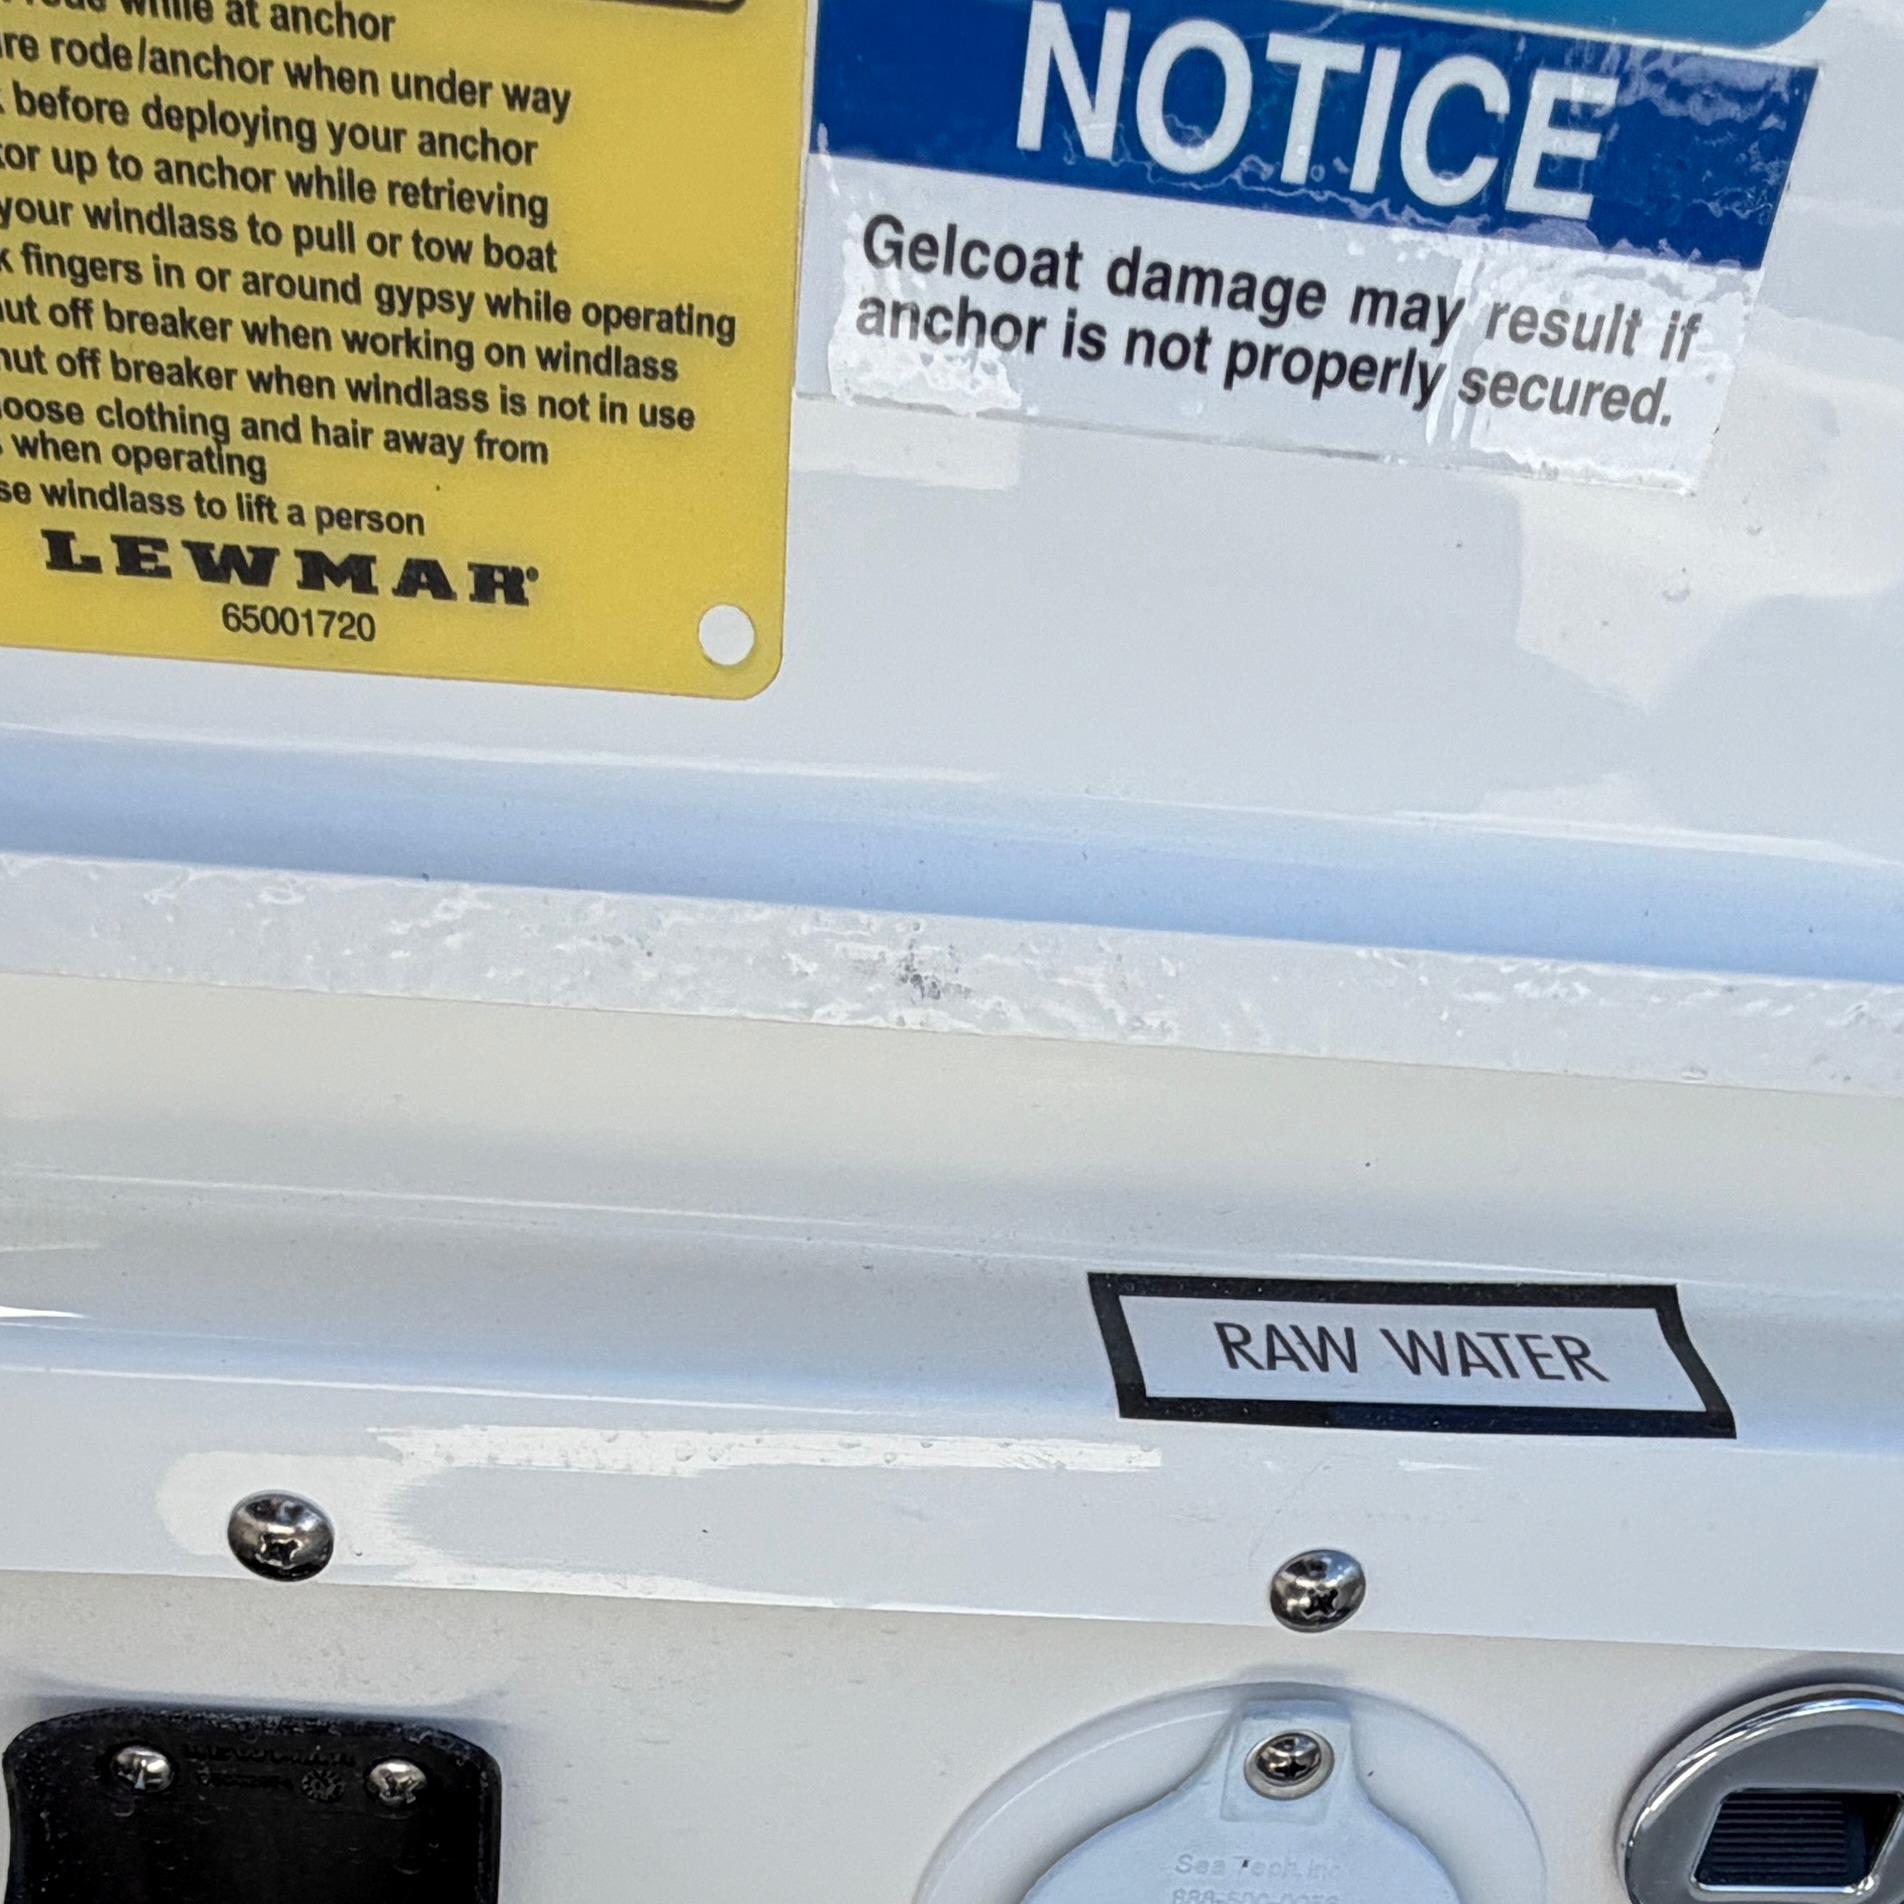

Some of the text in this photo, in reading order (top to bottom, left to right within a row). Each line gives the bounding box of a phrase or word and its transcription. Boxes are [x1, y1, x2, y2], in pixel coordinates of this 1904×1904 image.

[226, 0, 260, 28] at
[270, 0, 395, 42] anchor
[50, 33, 274, 85] rode/anchor
[284, 55, 379, 96] when
[391, 68, 493, 108] under
[502, 83, 571, 124] way
[1017, 0, 1619, 220] NOTICE
[13, 80, 129, 126] before
[142, 94, 317, 153] deploying
[327, 120, 407, 156] your
[418, 128, 538, 166] anchor
[51, 147, 97, 184] up
[107, 146, 143, 181] to
[155, 155, 276, 193] anchor
[285, 165, 376, 204] while
[388, 177, 548, 229] retrieving
[83, 198, 238, 242] windlass
[247, 213, 282, 246] to
[293, 220, 355, 257] pull
[367, 232, 402, 257] or
[412, 229, 473, 264] tow
[484, 234, 557, 273] boat
[21, 242, 143, 288] fingers
[153, 254, 185, 288] in
[196, 267, 231, 292] or
[243, 271, 361, 305] around
[375, 283, 475, 323] gypsy
[485, 287, 571, 324] while
[582, 303, 735, 347] operating
[863, 213, 1703, 362] Gelcoat damage may result if
[49, 297, 93, 330] off
[103, 299, 232, 342] breaker
[241, 315, 332, 351] when
[342, 327, 474, 372] working
[485, 343, 525, 368] on
[536, 341, 678, 382] windlass
[856, 295, 1673, 427] anchor is not properly secured.
[56, 347, 100, 379] off
[110, 350, 238, 390] breaker
[247, 364, 335, 399] when
[345, 373, 489, 413] windlass
[500, 384, 526, 416] is
[539, 393, 589, 422] not
[600, 393, 627, 424] in
[639, 404, 695, 431] use
[96, 397, 231, 444] clothing
[241, 414, 301, 443] and
[311, 415, 374, 449] hair
[384, 429, 464, 464] away
[474, 429, 548, 464] from
[11, 429, 101, 464] when
[112, 439, 267, 485] operating
[40, 478, 185, 516] windlass
[194, 491, 227, 520] to
[236, 492, 278, 524] lift
[288, 504, 305, 527] a
[316, 506, 424, 536] person
[222, 603, 375, 641] 65001720
[1213, 1321, 1610, 1383] RAW WATER
